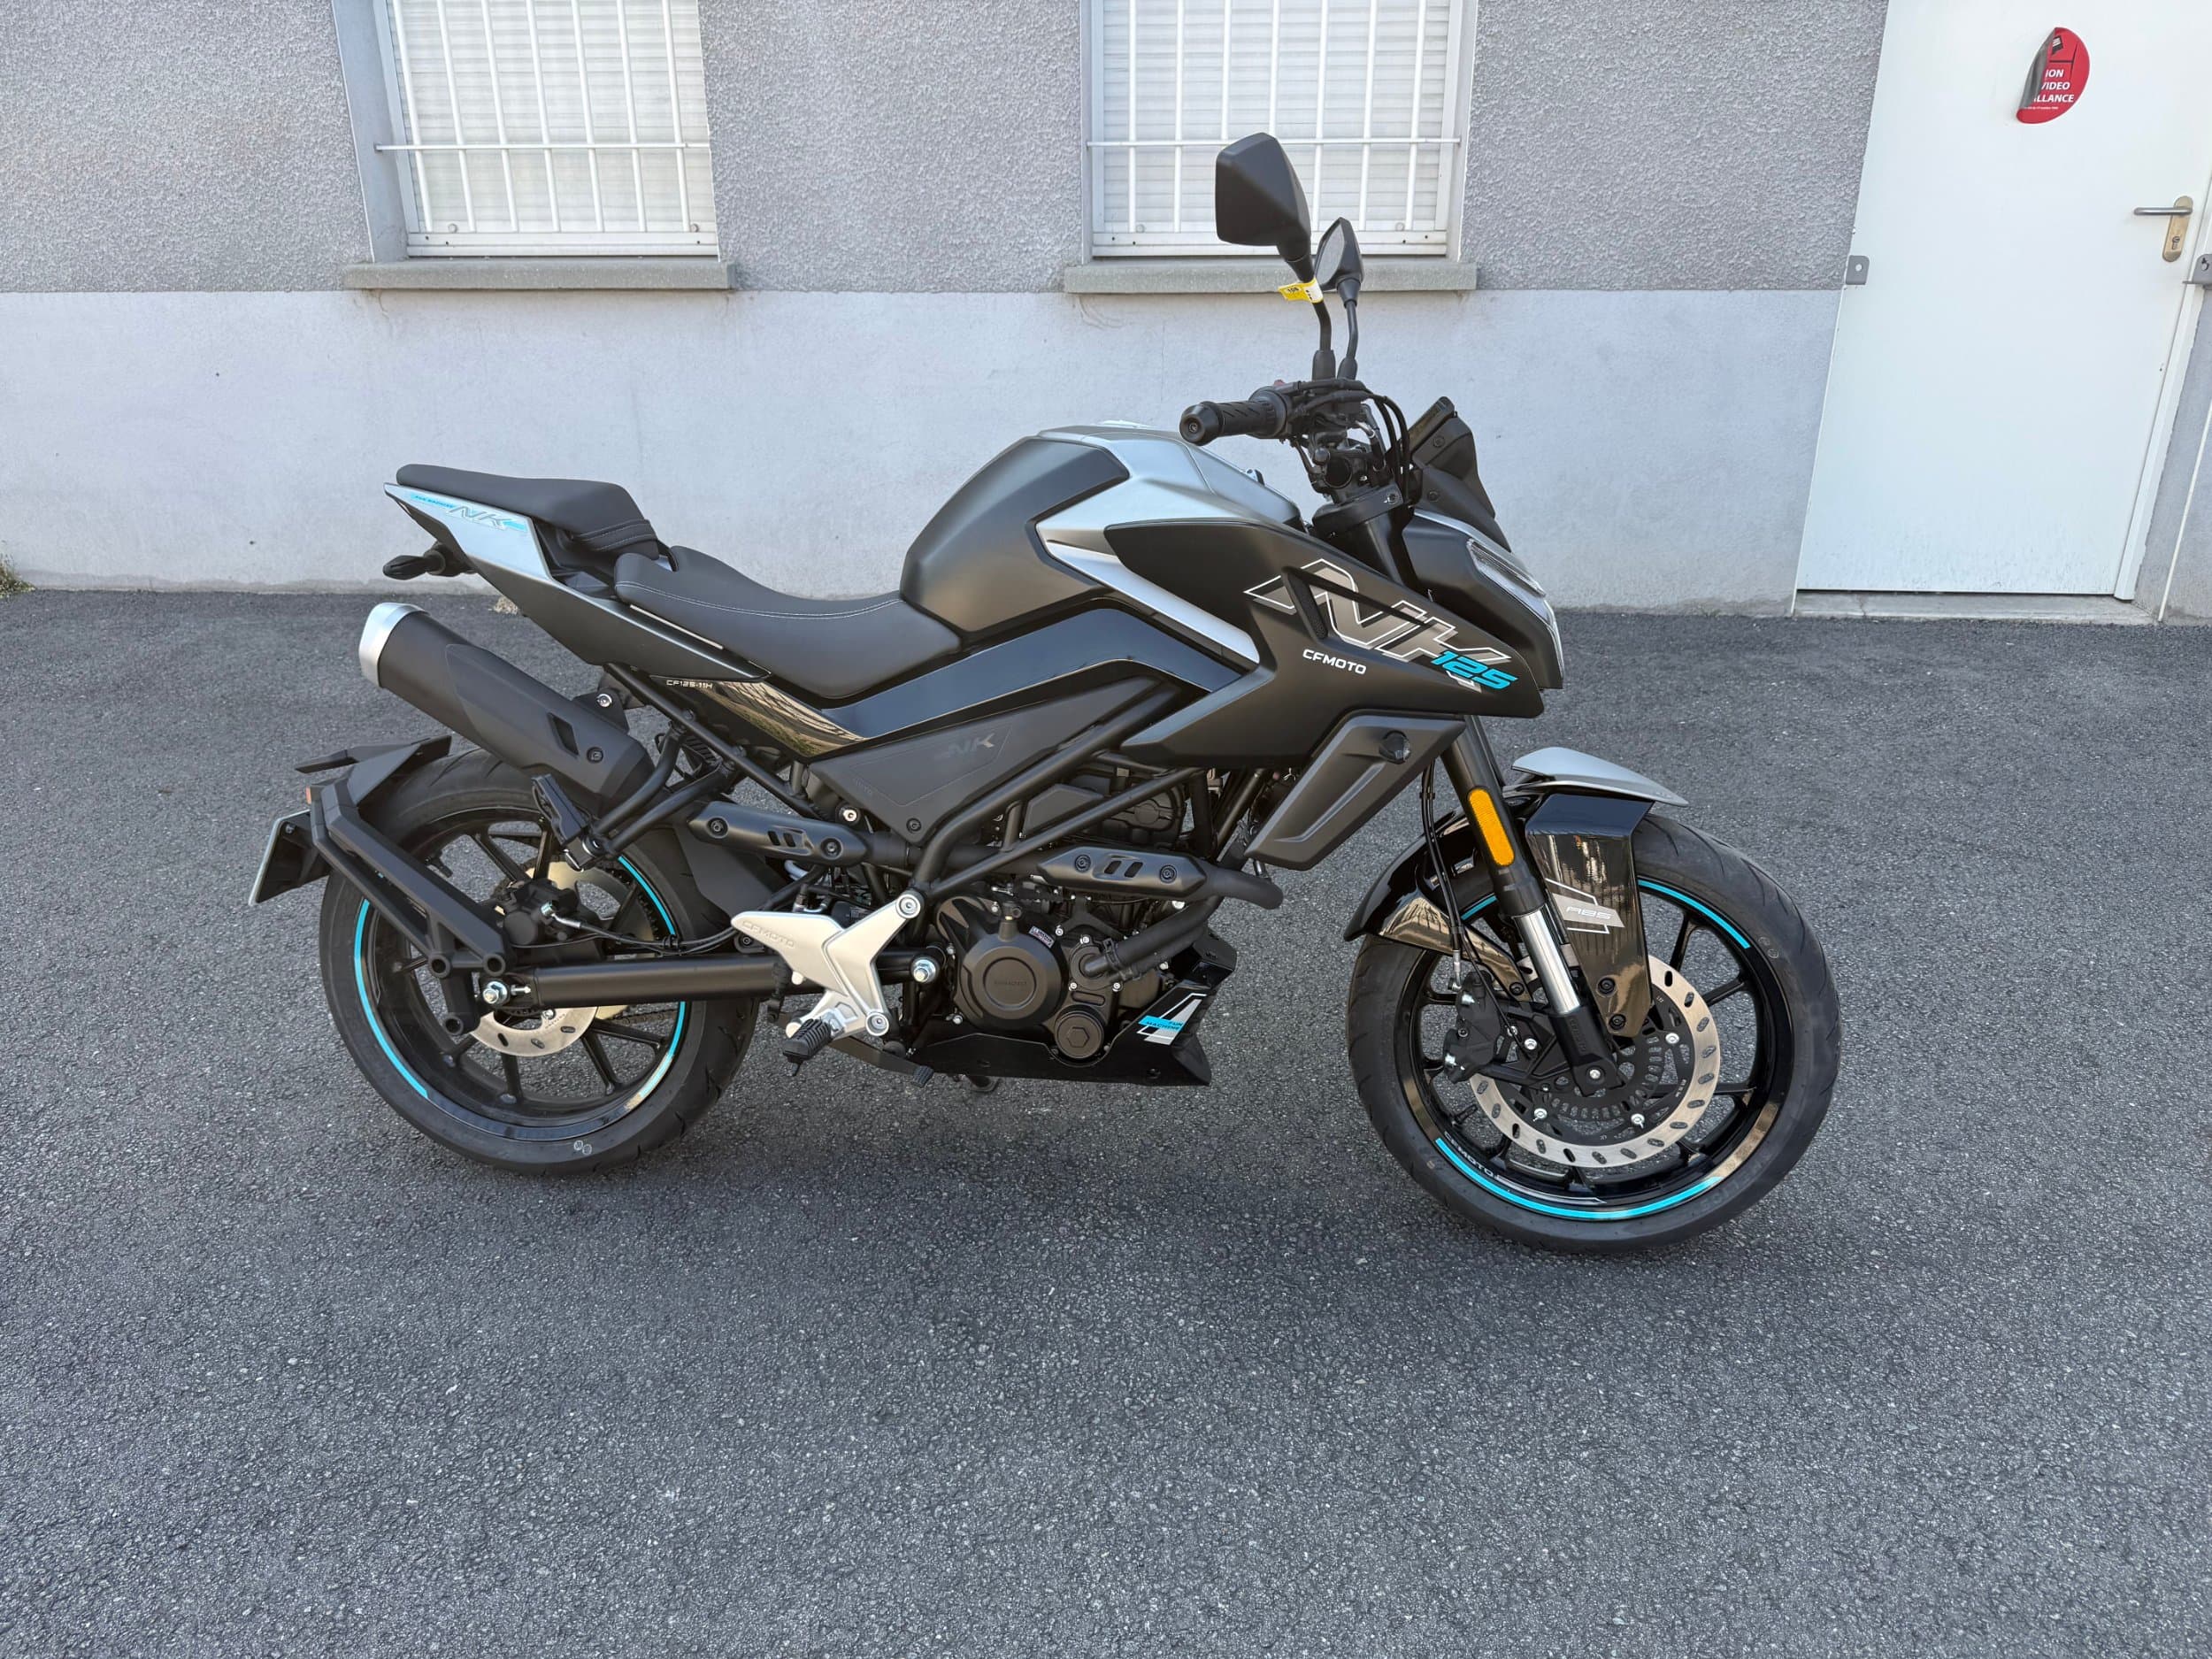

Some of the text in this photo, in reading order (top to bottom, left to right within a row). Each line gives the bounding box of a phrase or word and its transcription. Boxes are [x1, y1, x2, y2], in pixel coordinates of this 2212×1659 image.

[449, 505, 514, 529] NK
[1302, 649, 1367, 675] CFMOTO
[1432, 650, 1519, 690] 125
[1566, 906, 1612, 920] ABS
